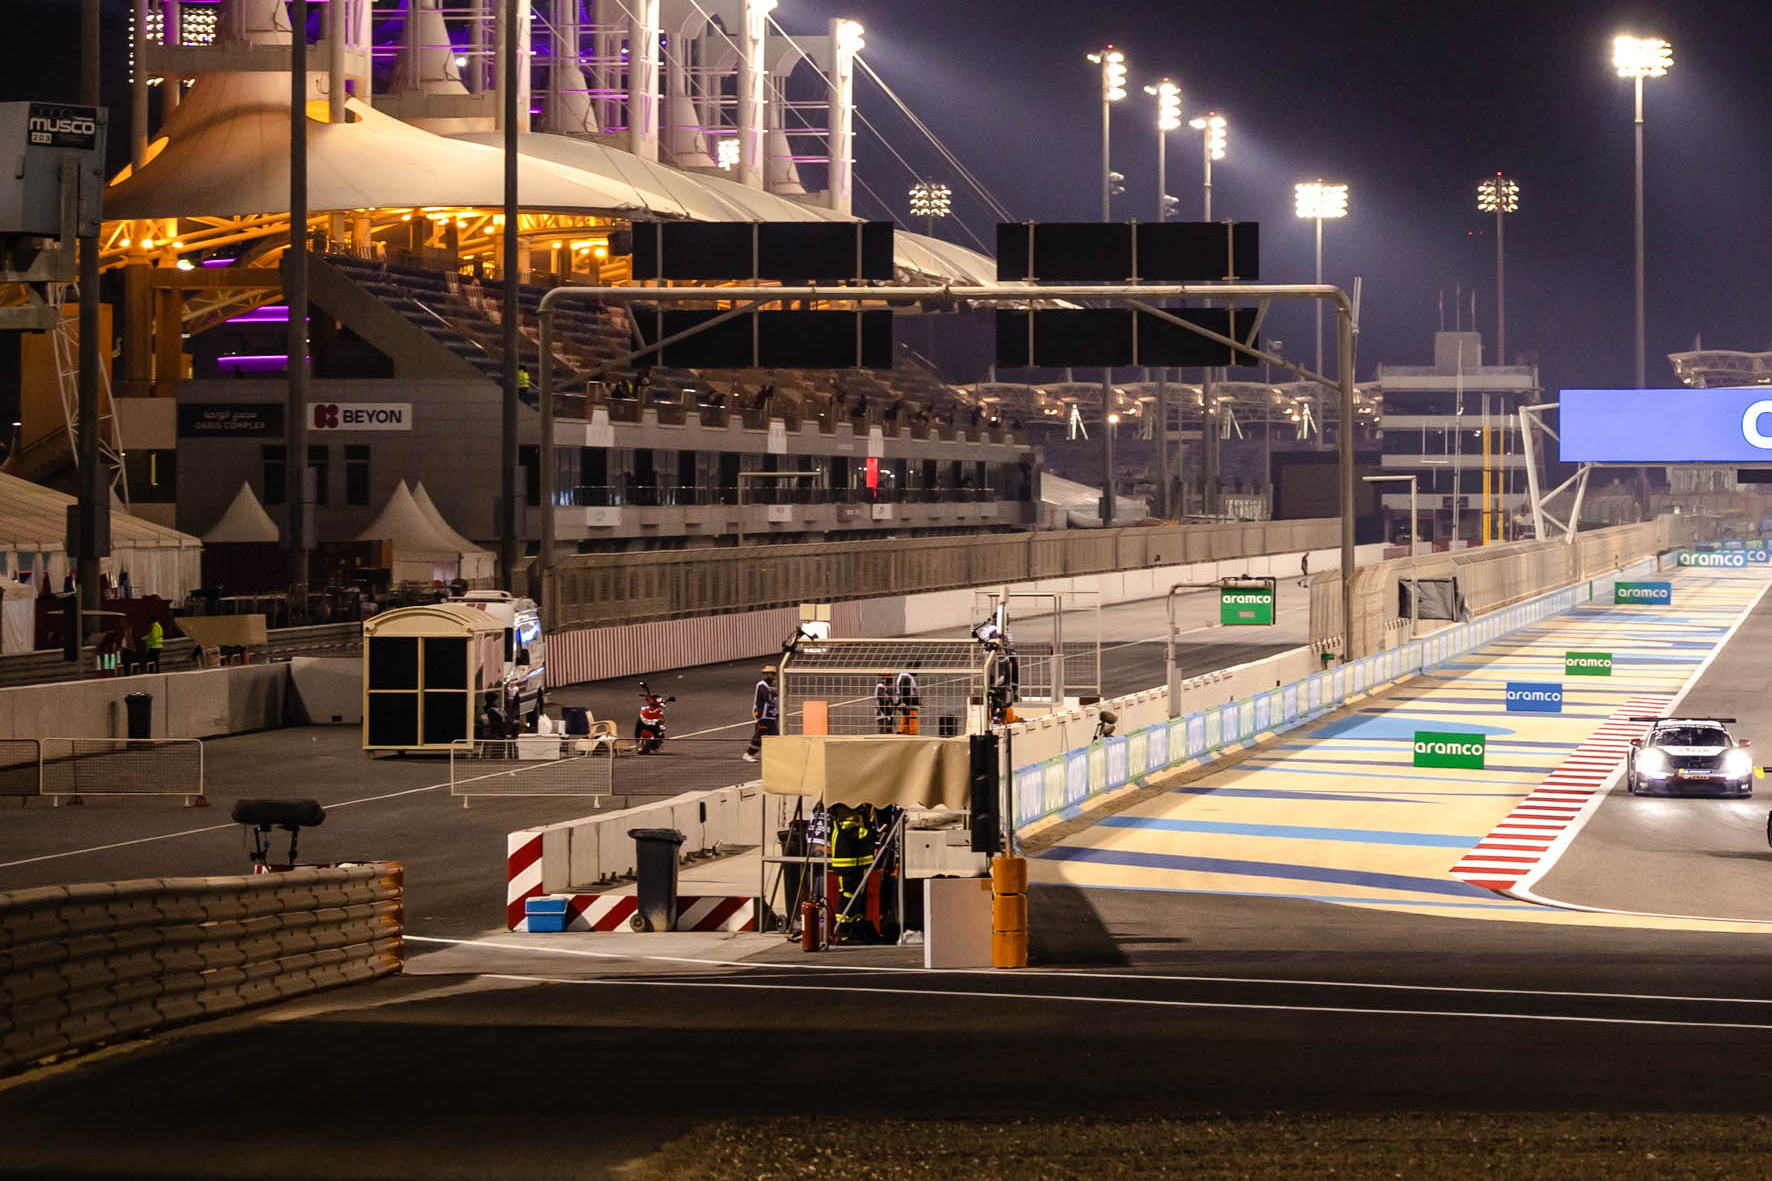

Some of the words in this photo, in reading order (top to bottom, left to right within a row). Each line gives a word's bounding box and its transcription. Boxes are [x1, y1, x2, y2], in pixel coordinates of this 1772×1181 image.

[343, 409, 402, 424] BEYON
[1680, 552, 1744, 566] aramco
[1618, 587, 1668, 598] aramco
[1222, 595, 1272, 603] aramco
[1566, 657, 1612, 668] aramco
[1507, 690, 1561, 702] aramco
[1415, 741, 1483, 756] aramco
